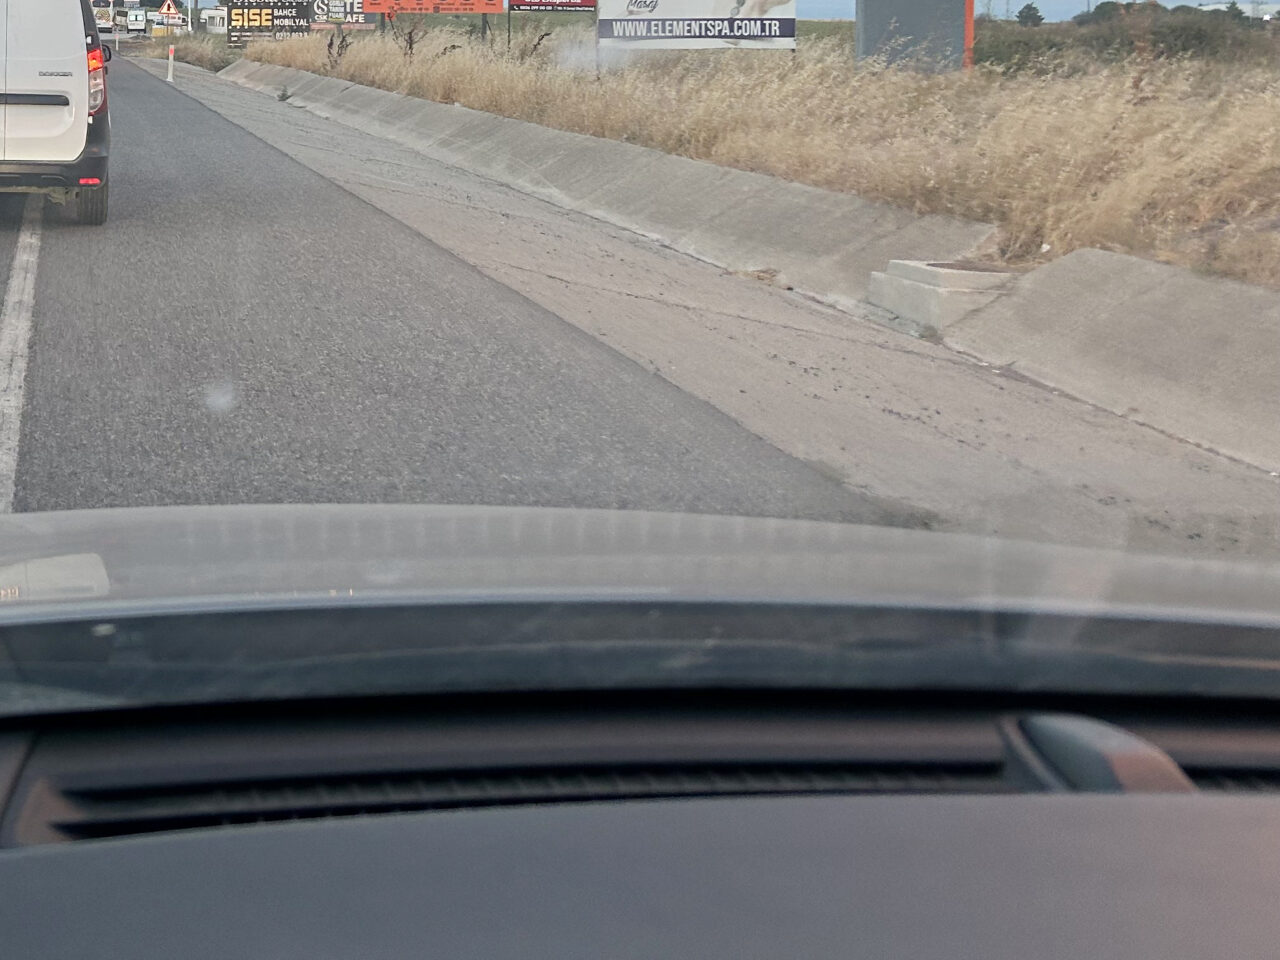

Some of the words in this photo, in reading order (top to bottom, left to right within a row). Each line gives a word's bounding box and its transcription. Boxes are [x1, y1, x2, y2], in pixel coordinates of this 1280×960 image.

[273, 8, 297, 17] BAHÇE
[345, 14, 365, 22] AFE
[613, 20, 780, 36] WWW.ELEMENTSPA.COM.TR
